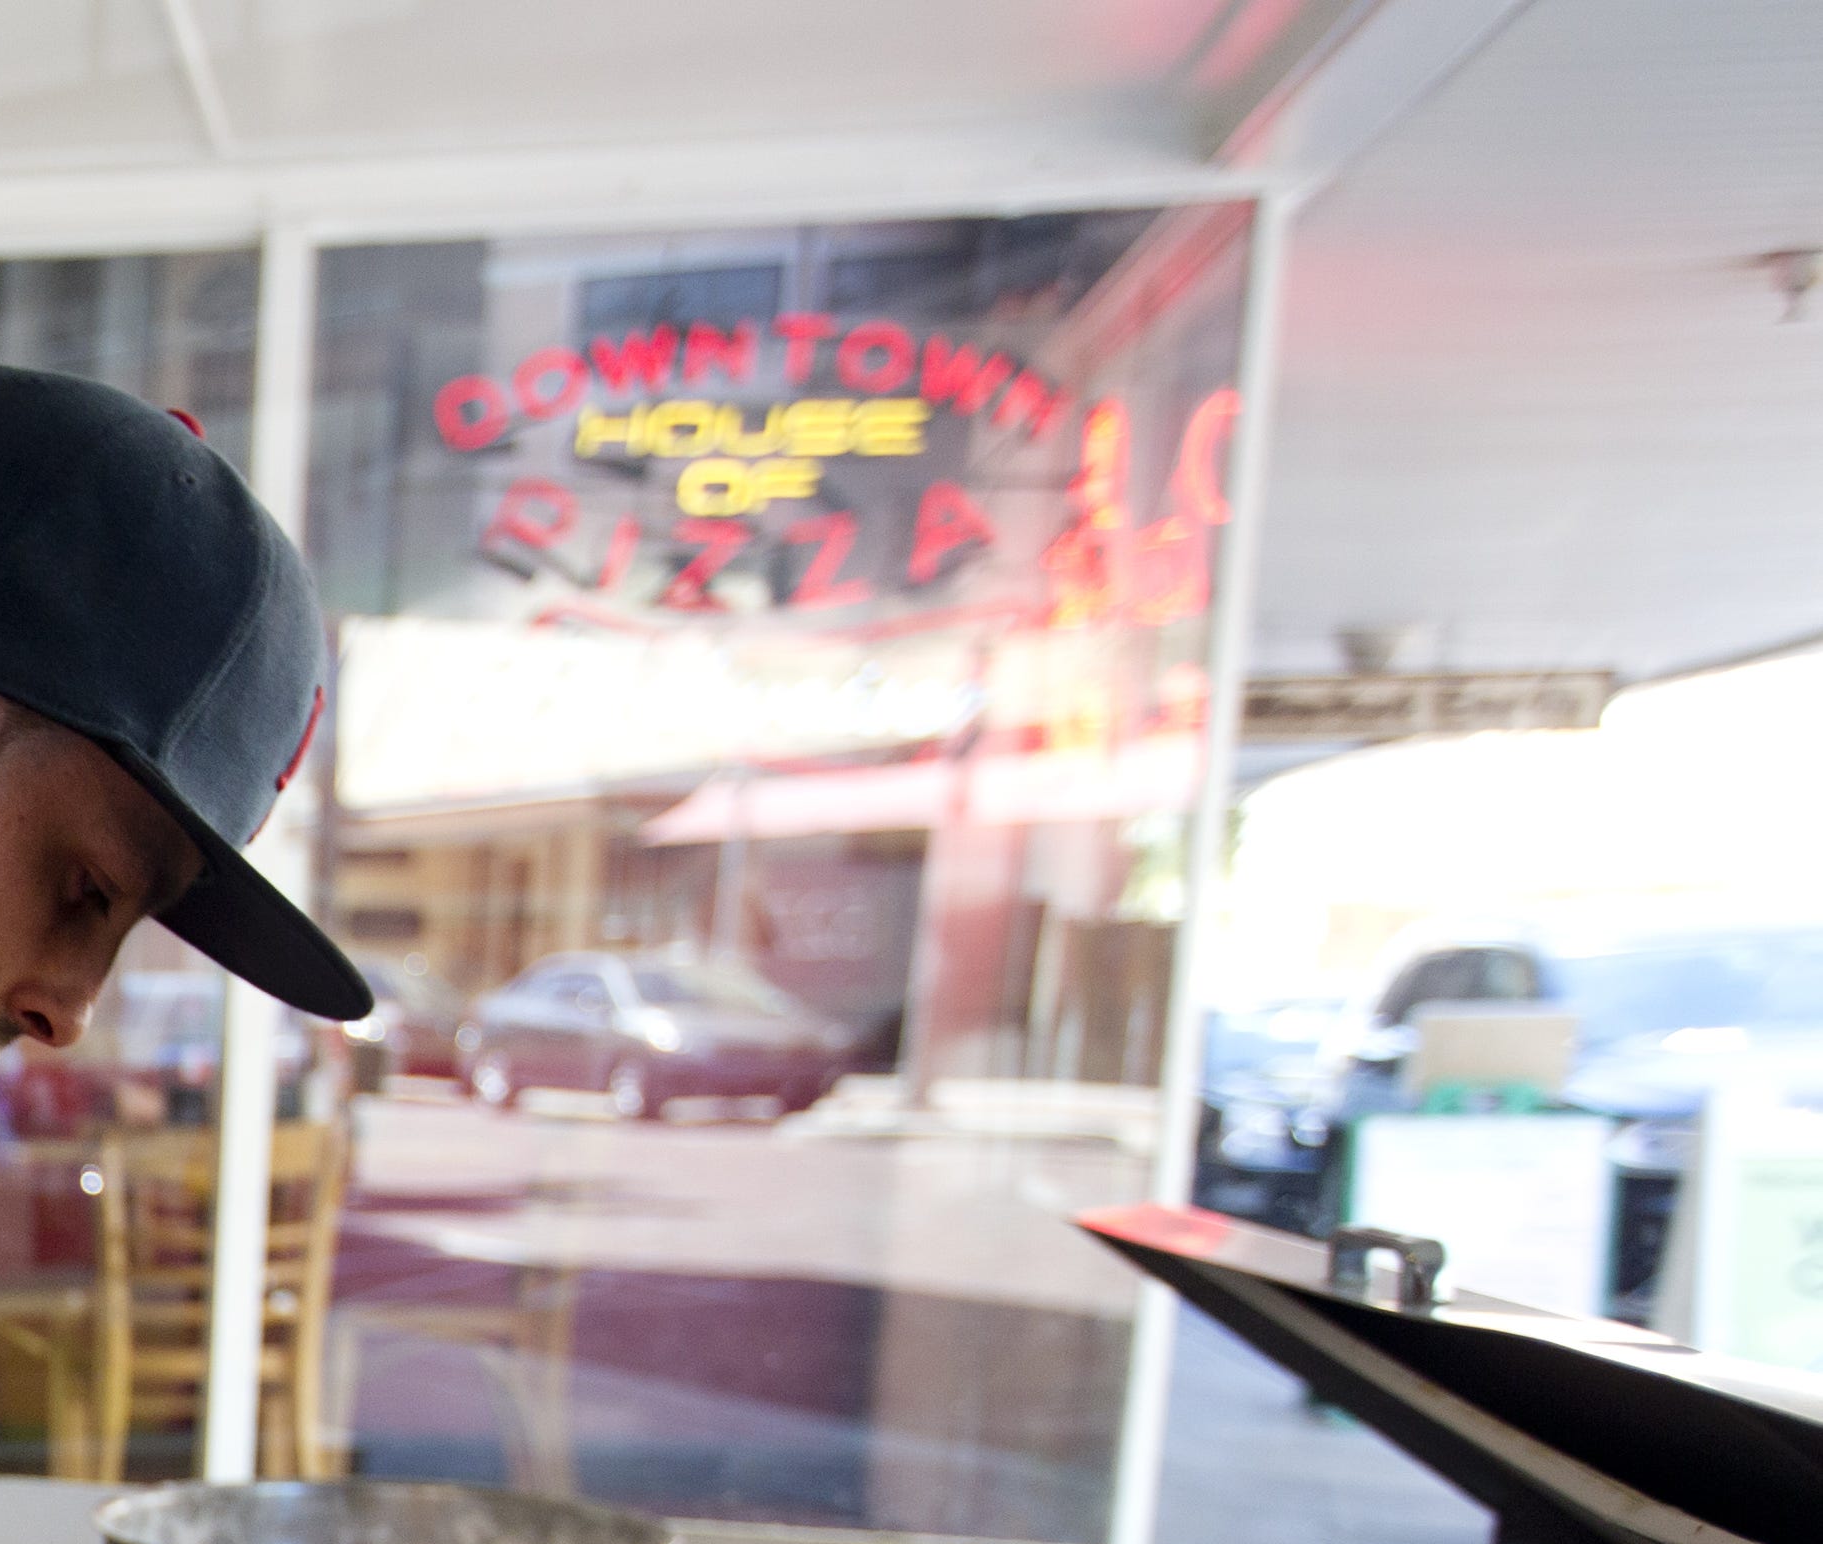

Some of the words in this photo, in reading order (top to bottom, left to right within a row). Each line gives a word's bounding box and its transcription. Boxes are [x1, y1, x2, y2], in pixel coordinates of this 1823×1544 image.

[435, 314, 1071, 451] DOWNTOWN
[574, 398, 932, 459] HOUSE
[676, 458, 825, 518] OF
[483, 480, 994, 612] PIZZA
